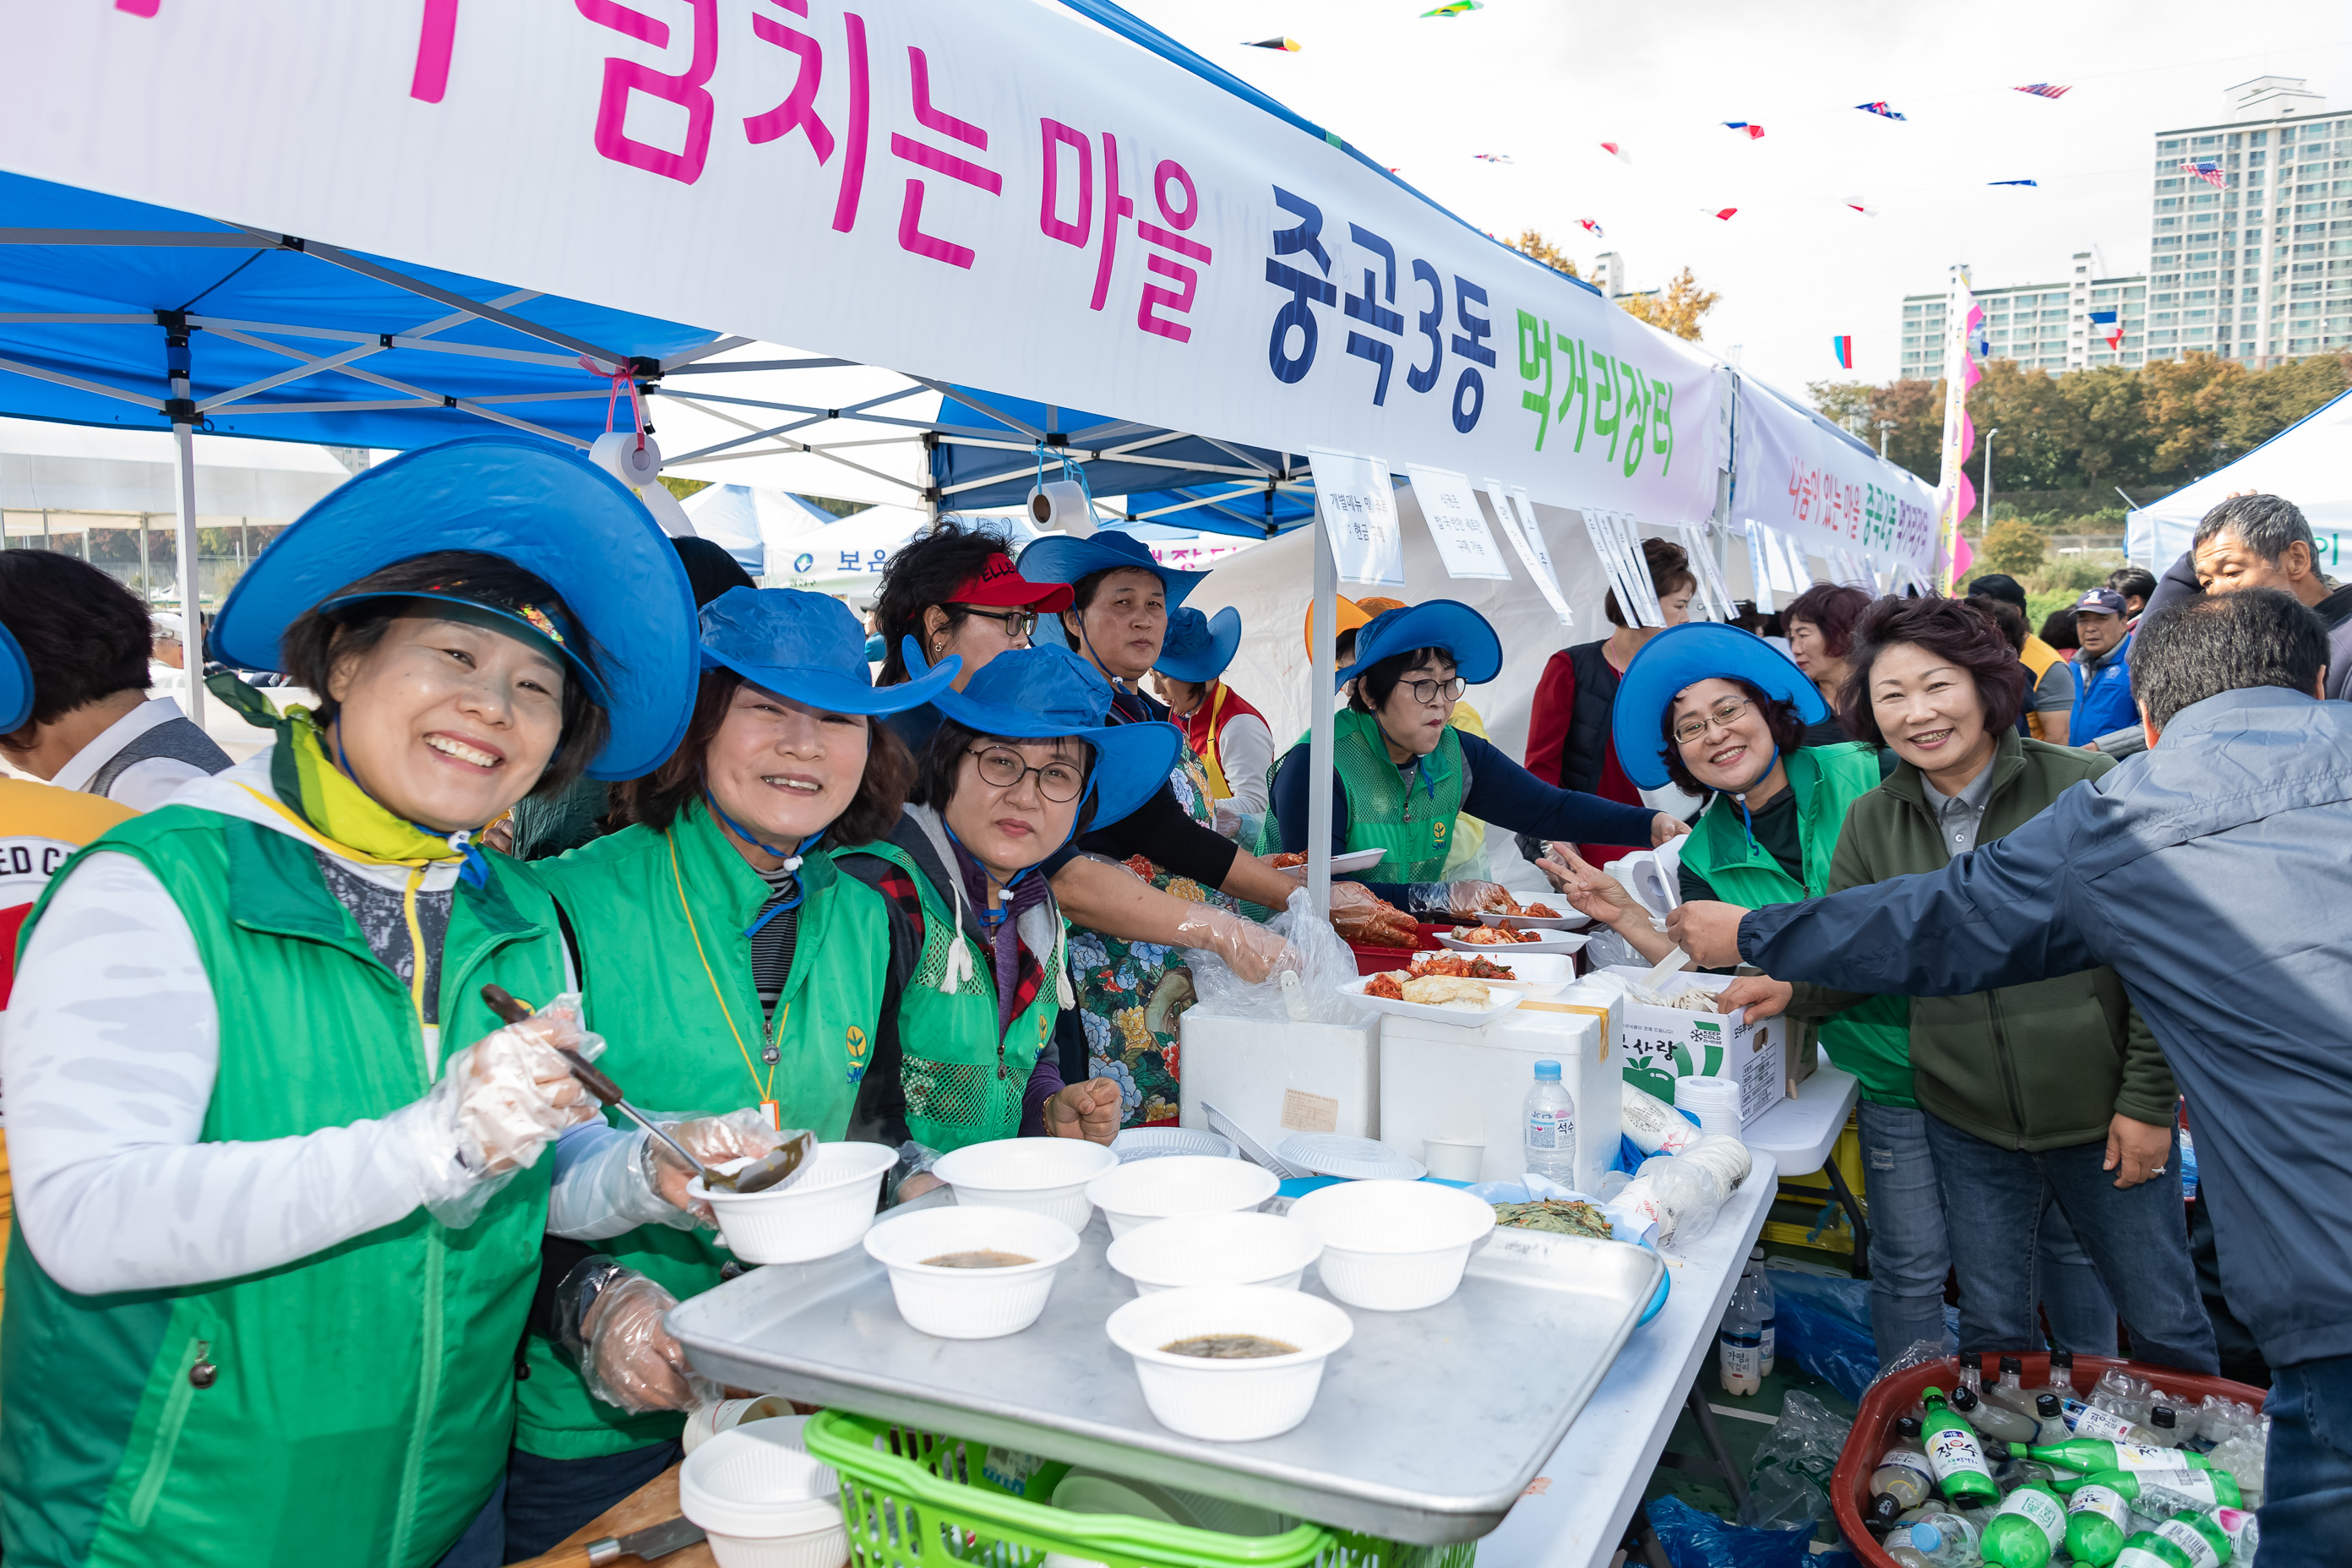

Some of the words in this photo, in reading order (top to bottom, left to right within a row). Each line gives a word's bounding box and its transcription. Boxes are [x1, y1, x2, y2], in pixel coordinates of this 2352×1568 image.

[1040, 117, 1213, 345] 마을
[1266, 183, 1497, 434] 중곡3동
[1516, 308, 1673, 478] 먹거리장터
[1330, 493, 1363, 513] 개별메뉴
[1788, 456, 1821, 525] 나눔이
[1822, 473, 1843, 531] 있는
[1843, 483, 1860, 541] 마을
[1863, 482, 1897, 553] 중곡2동
[1353, 522, 1369, 542] 현금
[1557, 1121, 1575, 1135] 석수
[1727, 1351, 1745, 1363] 가평
[1936, 1442, 1979, 1459] 장수
